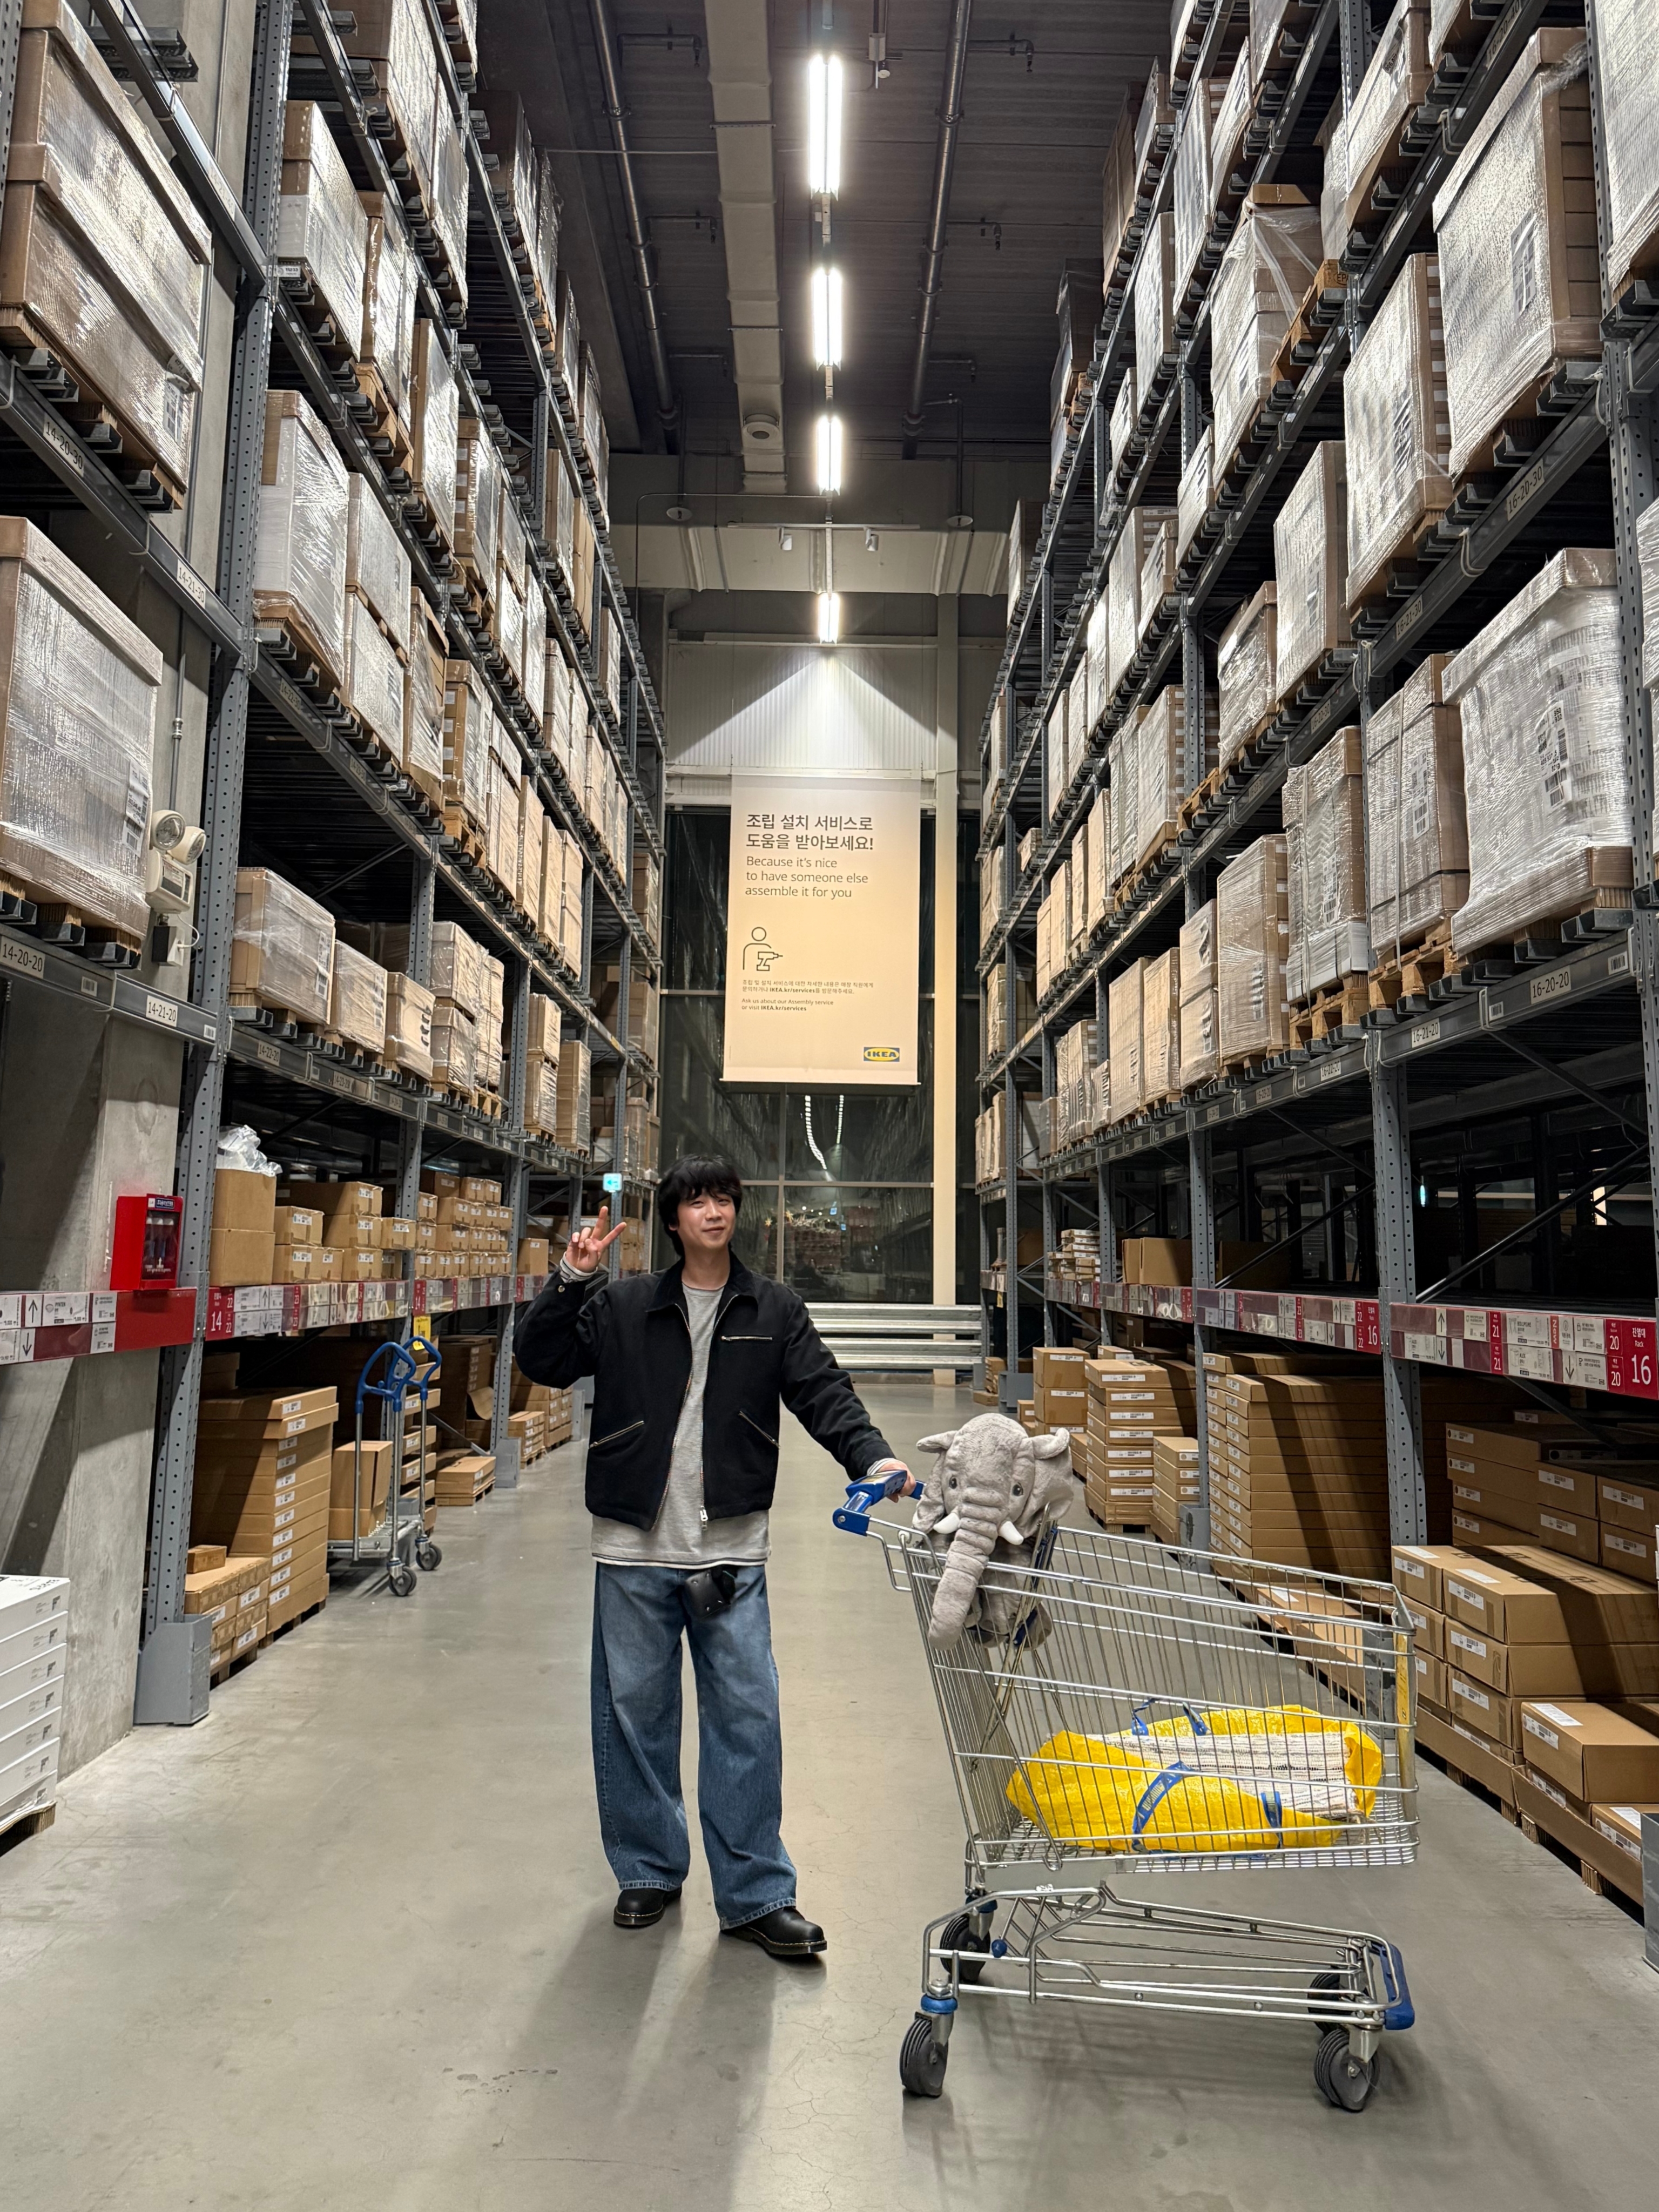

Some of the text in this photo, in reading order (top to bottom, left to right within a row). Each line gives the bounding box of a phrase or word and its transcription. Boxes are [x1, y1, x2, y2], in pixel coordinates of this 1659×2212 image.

[46, 422, 83, 469] 14-20-30
[1509, 466, 1542, 514] 16-20-30
[179, 567, 205, 603] 14-21-30
[1398, 600, 1421, 636] 16-21-30
[746, 814, 873, 831] 조립 설치 서비스로
[746, 833, 873, 851] 도움을 받아보세요!
[747, 856, 837, 868] Because it's nice
[746, 871, 868, 884] to have someone else
[745, 886, 852, 900] assemble it for you
[2, 943, 43, 972] 14-20-20
[1533, 971, 1569, 999] 16-20-20
[148, 1001, 176, 1022] 14-21-20
[1413, 1022, 1439, 1043] 16-21-20
[259, 1044, 280, 1062] 14-22-20
[867, 1050, 896, 1058] IKEA
[1322, 1061, 1340, 1077] 16-22-20
[227, 1297, 233, 1308] 22
[294, 1295, 299, 1304] 23
[1297, 1306, 1301, 1315] 23
[1357, 1312, 1363, 1321] 22
[211, 1311, 222, 1331] 14
[226, 1323, 232, 1333] 22
[1298, 1329, 1303, 1338] 23
[1367, 1325, 1378, 1345] 16
[1492, 1325, 1500, 1338] 21
[1632, 1327, 1646, 1338] 진열대
[1358, 1338, 1364, 1348] 22
[1609, 1335, 1620, 1350] 20
[1494, 1357, 1501, 1370] 21
[1631, 1354, 1651, 1385] 16
[1611, 1371, 1621, 1386] 20
